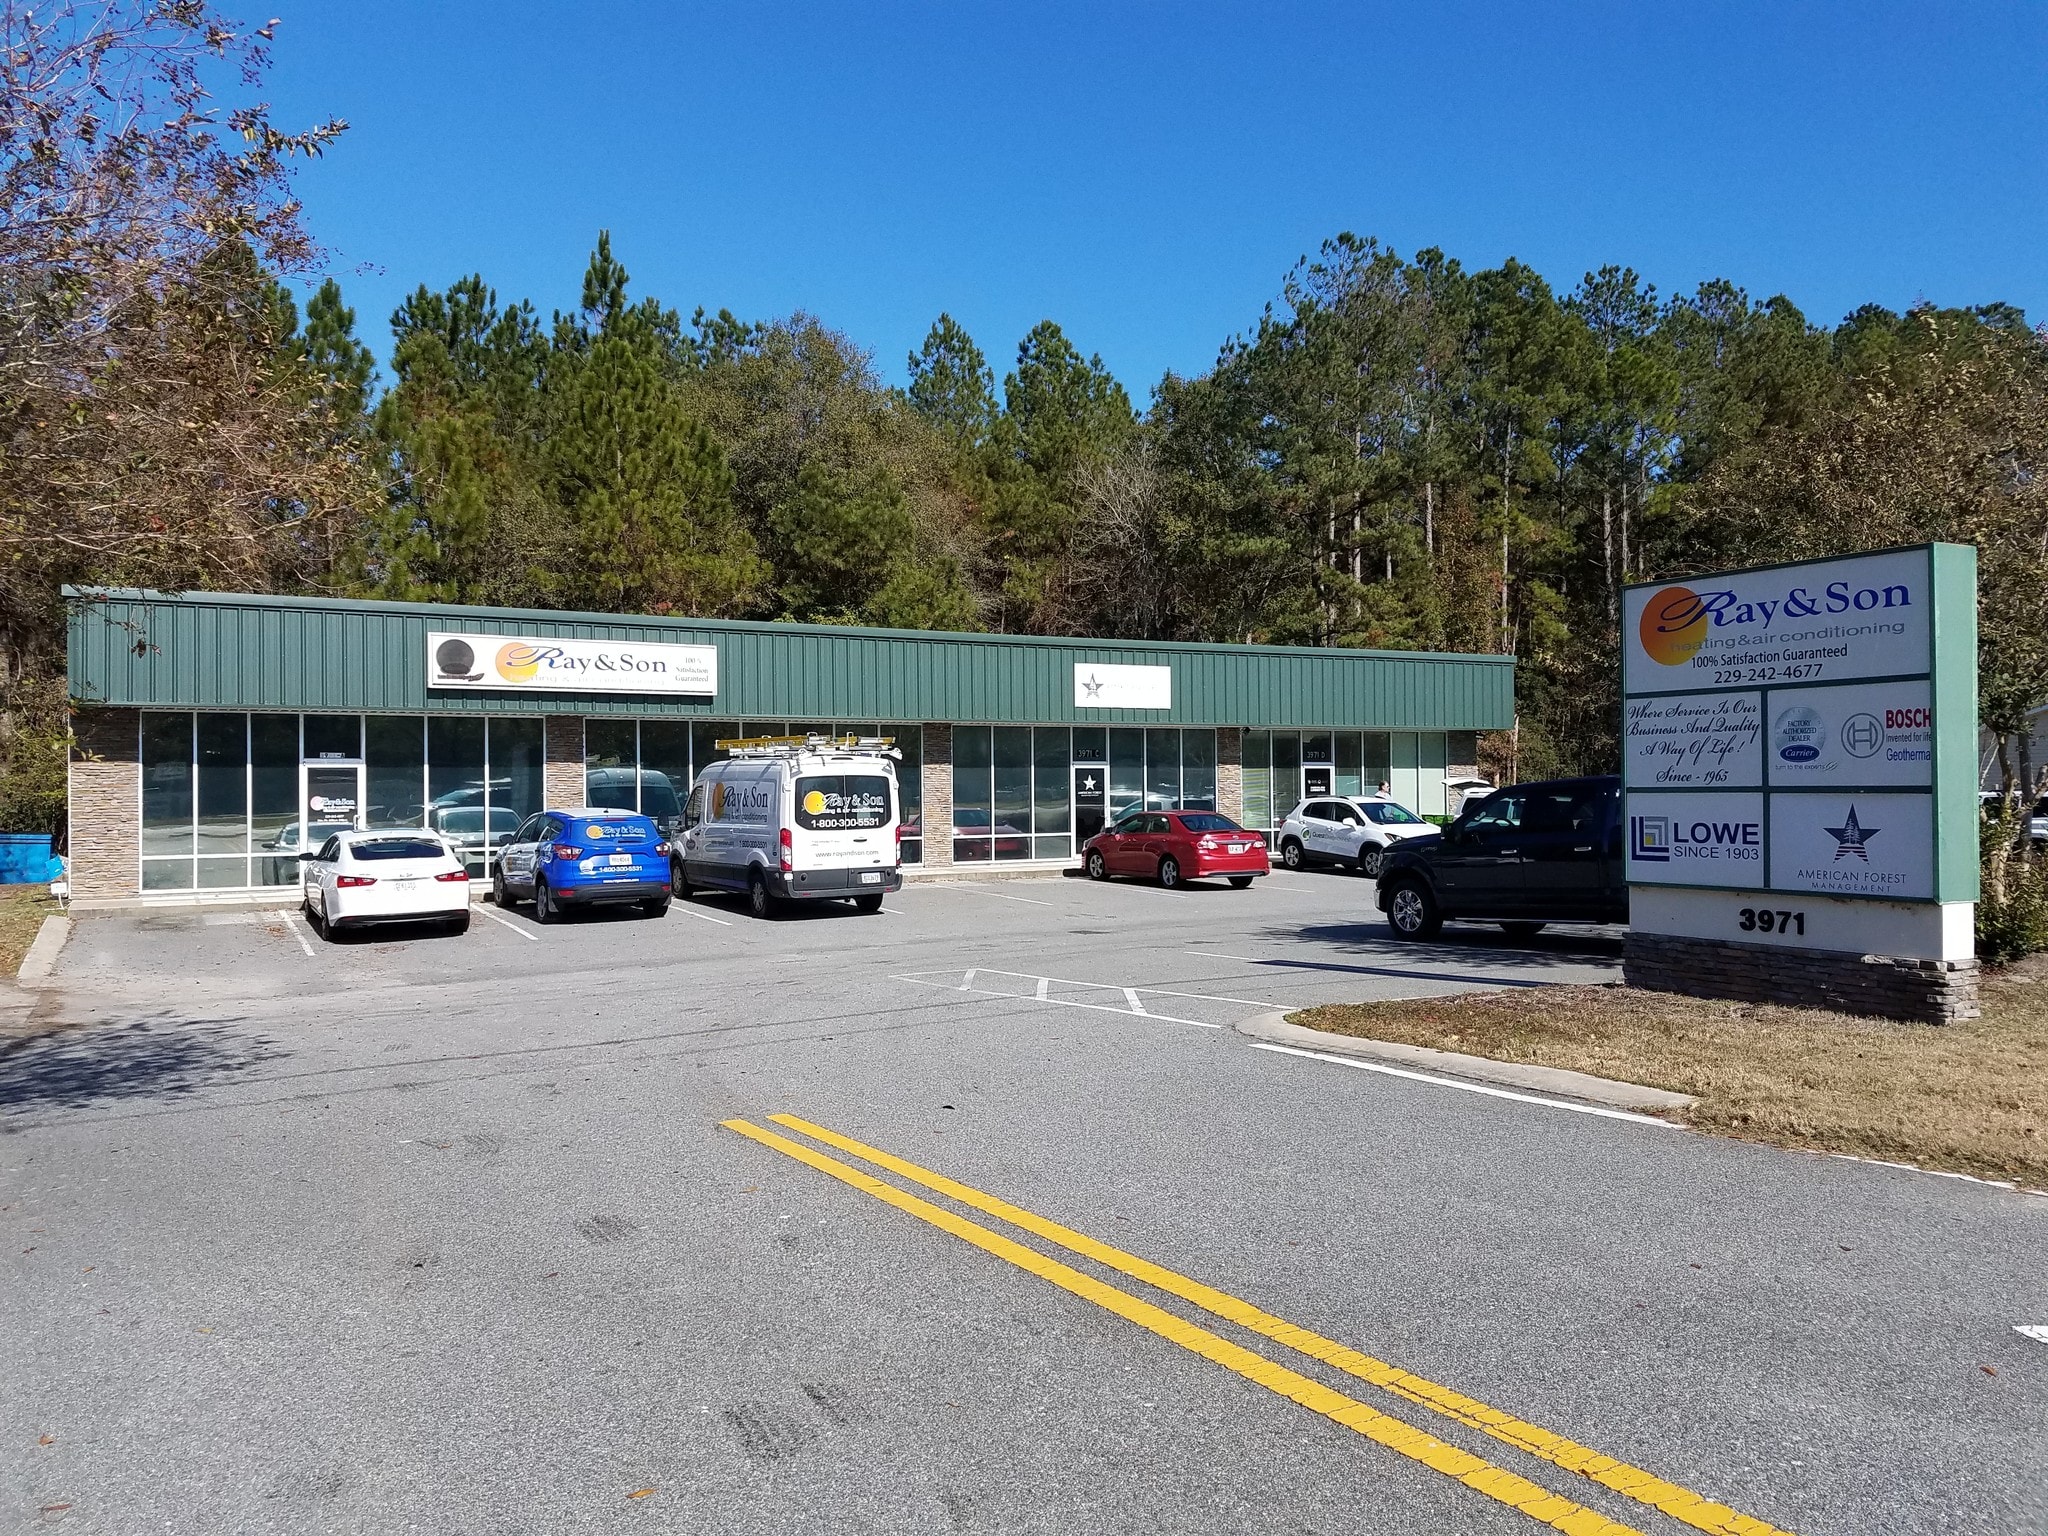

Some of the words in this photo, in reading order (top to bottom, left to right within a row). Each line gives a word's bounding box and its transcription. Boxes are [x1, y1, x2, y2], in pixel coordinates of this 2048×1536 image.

[1780, 622, 1905, 642] conditioning
[1692, 656, 1718, 669] 100%
[1721, 651, 1780, 667] Satisfaction
[1783, 643, 1848, 661] Guaranteed
[1714, 663, 1823, 684] 229-242-4677
[1627, 700, 1663, 720] Where
[1665, 702, 1711, 719] Service
[1712, 700, 1729, 715] Is
[1732, 699, 1758, 714] Our
[1886, 708, 1931, 729] BOSCH
[1626, 718, 1678, 737] Business
[1680, 717, 1715, 735] And
[1712, 715, 1760, 744] Quality
[1783, 727, 1817, 735] AUTHORIZED
[1886, 733, 1912, 743] Invented
[1913, 732, 1922, 742] for
[1640, 741, 1658, 756] A
[1658, 740, 1686, 766] Way
[1689, 735, 1712, 766] Of
[1785, 749, 1815, 757] Carrier
[1656, 765, 1692, 783] Since
[1703, 768, 1730, 786] 1965
[811, 818, 880, 829] 1-800-300-5531
[1673, 822, 1760, 845] LOWE
[1673, 845, 1720, 859] SINCE
[1725, 847, 1760, 860] 1903
[1797, 870, 1859, 882] AMERICAN
[1864, 872, 1907, 884] FOREST
[1811, 882, 1892, 893] MANAGEMENT
[1739, 908, 1805, 936] 3971
